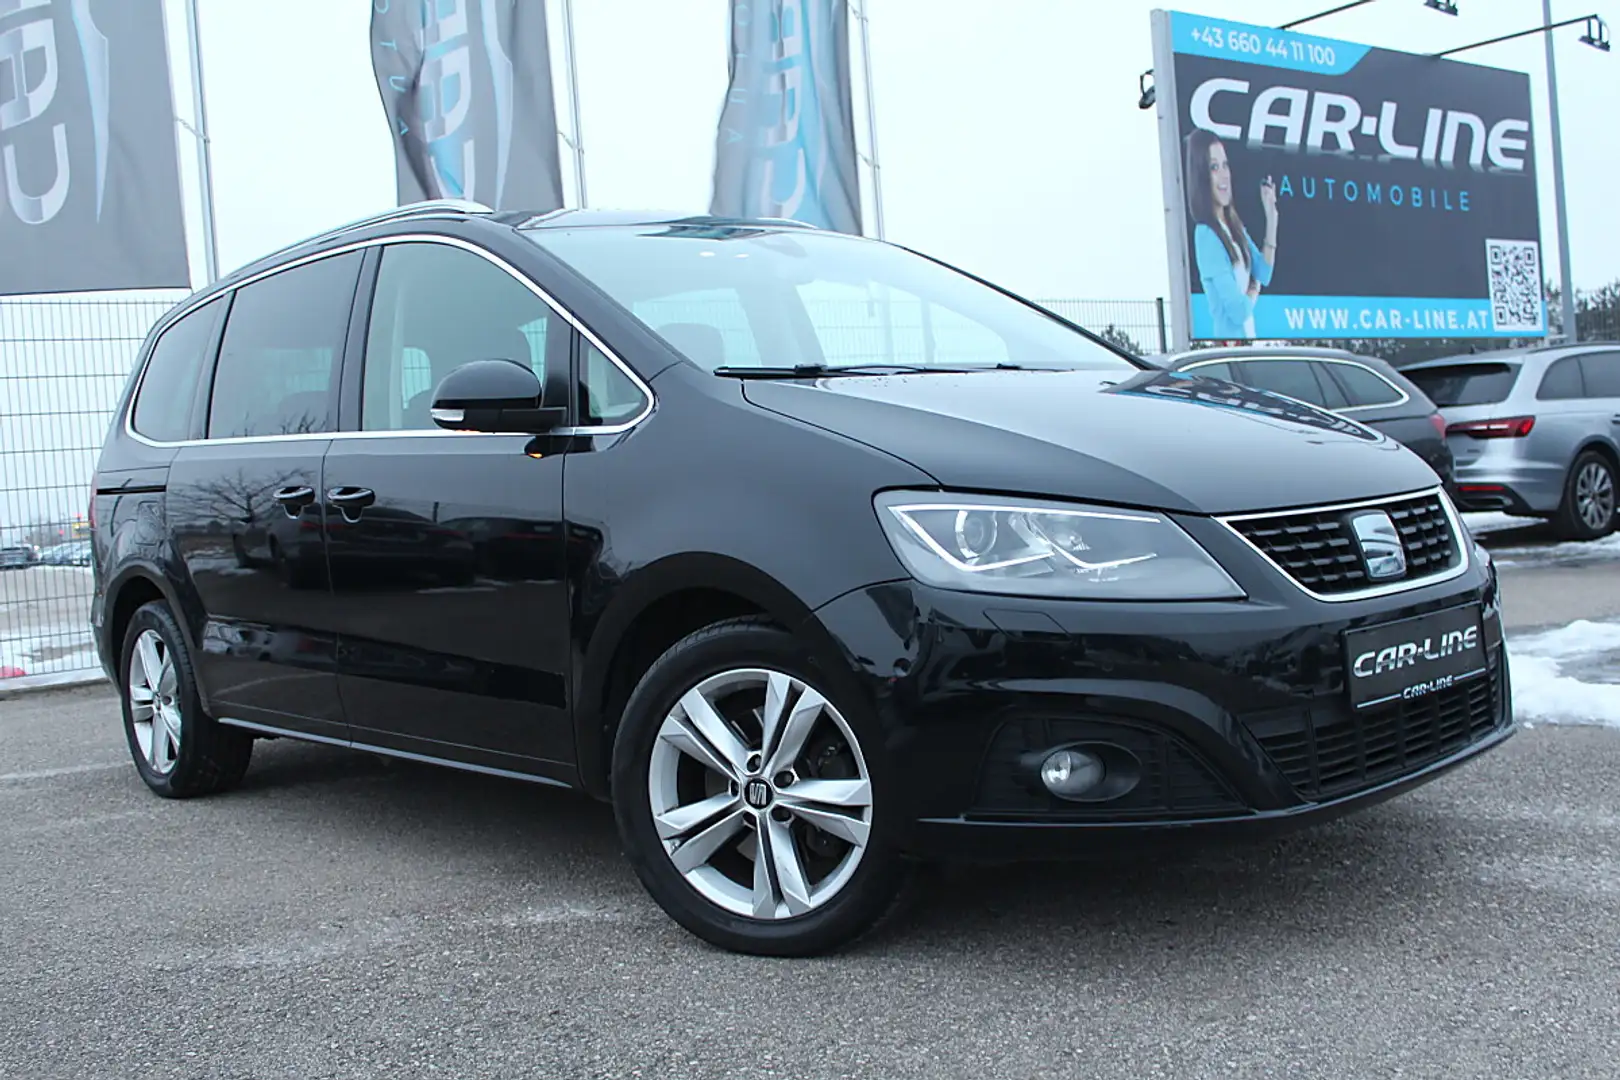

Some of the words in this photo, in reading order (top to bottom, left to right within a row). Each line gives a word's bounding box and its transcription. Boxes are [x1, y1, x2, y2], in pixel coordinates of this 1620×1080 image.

[1191, 26, 1224, 48] +43
[1228, 30, 1261, 54] 660
[1265, 37, 1288, 59] 44
[1290, 40, 1304, 62] 11
[1308, 43, 1336, 66] 100
[1279, 175, 1470, 212] AUTOMOBILE
[1284, 307, 1489, 330] WWW.CAR-LINE.AT
